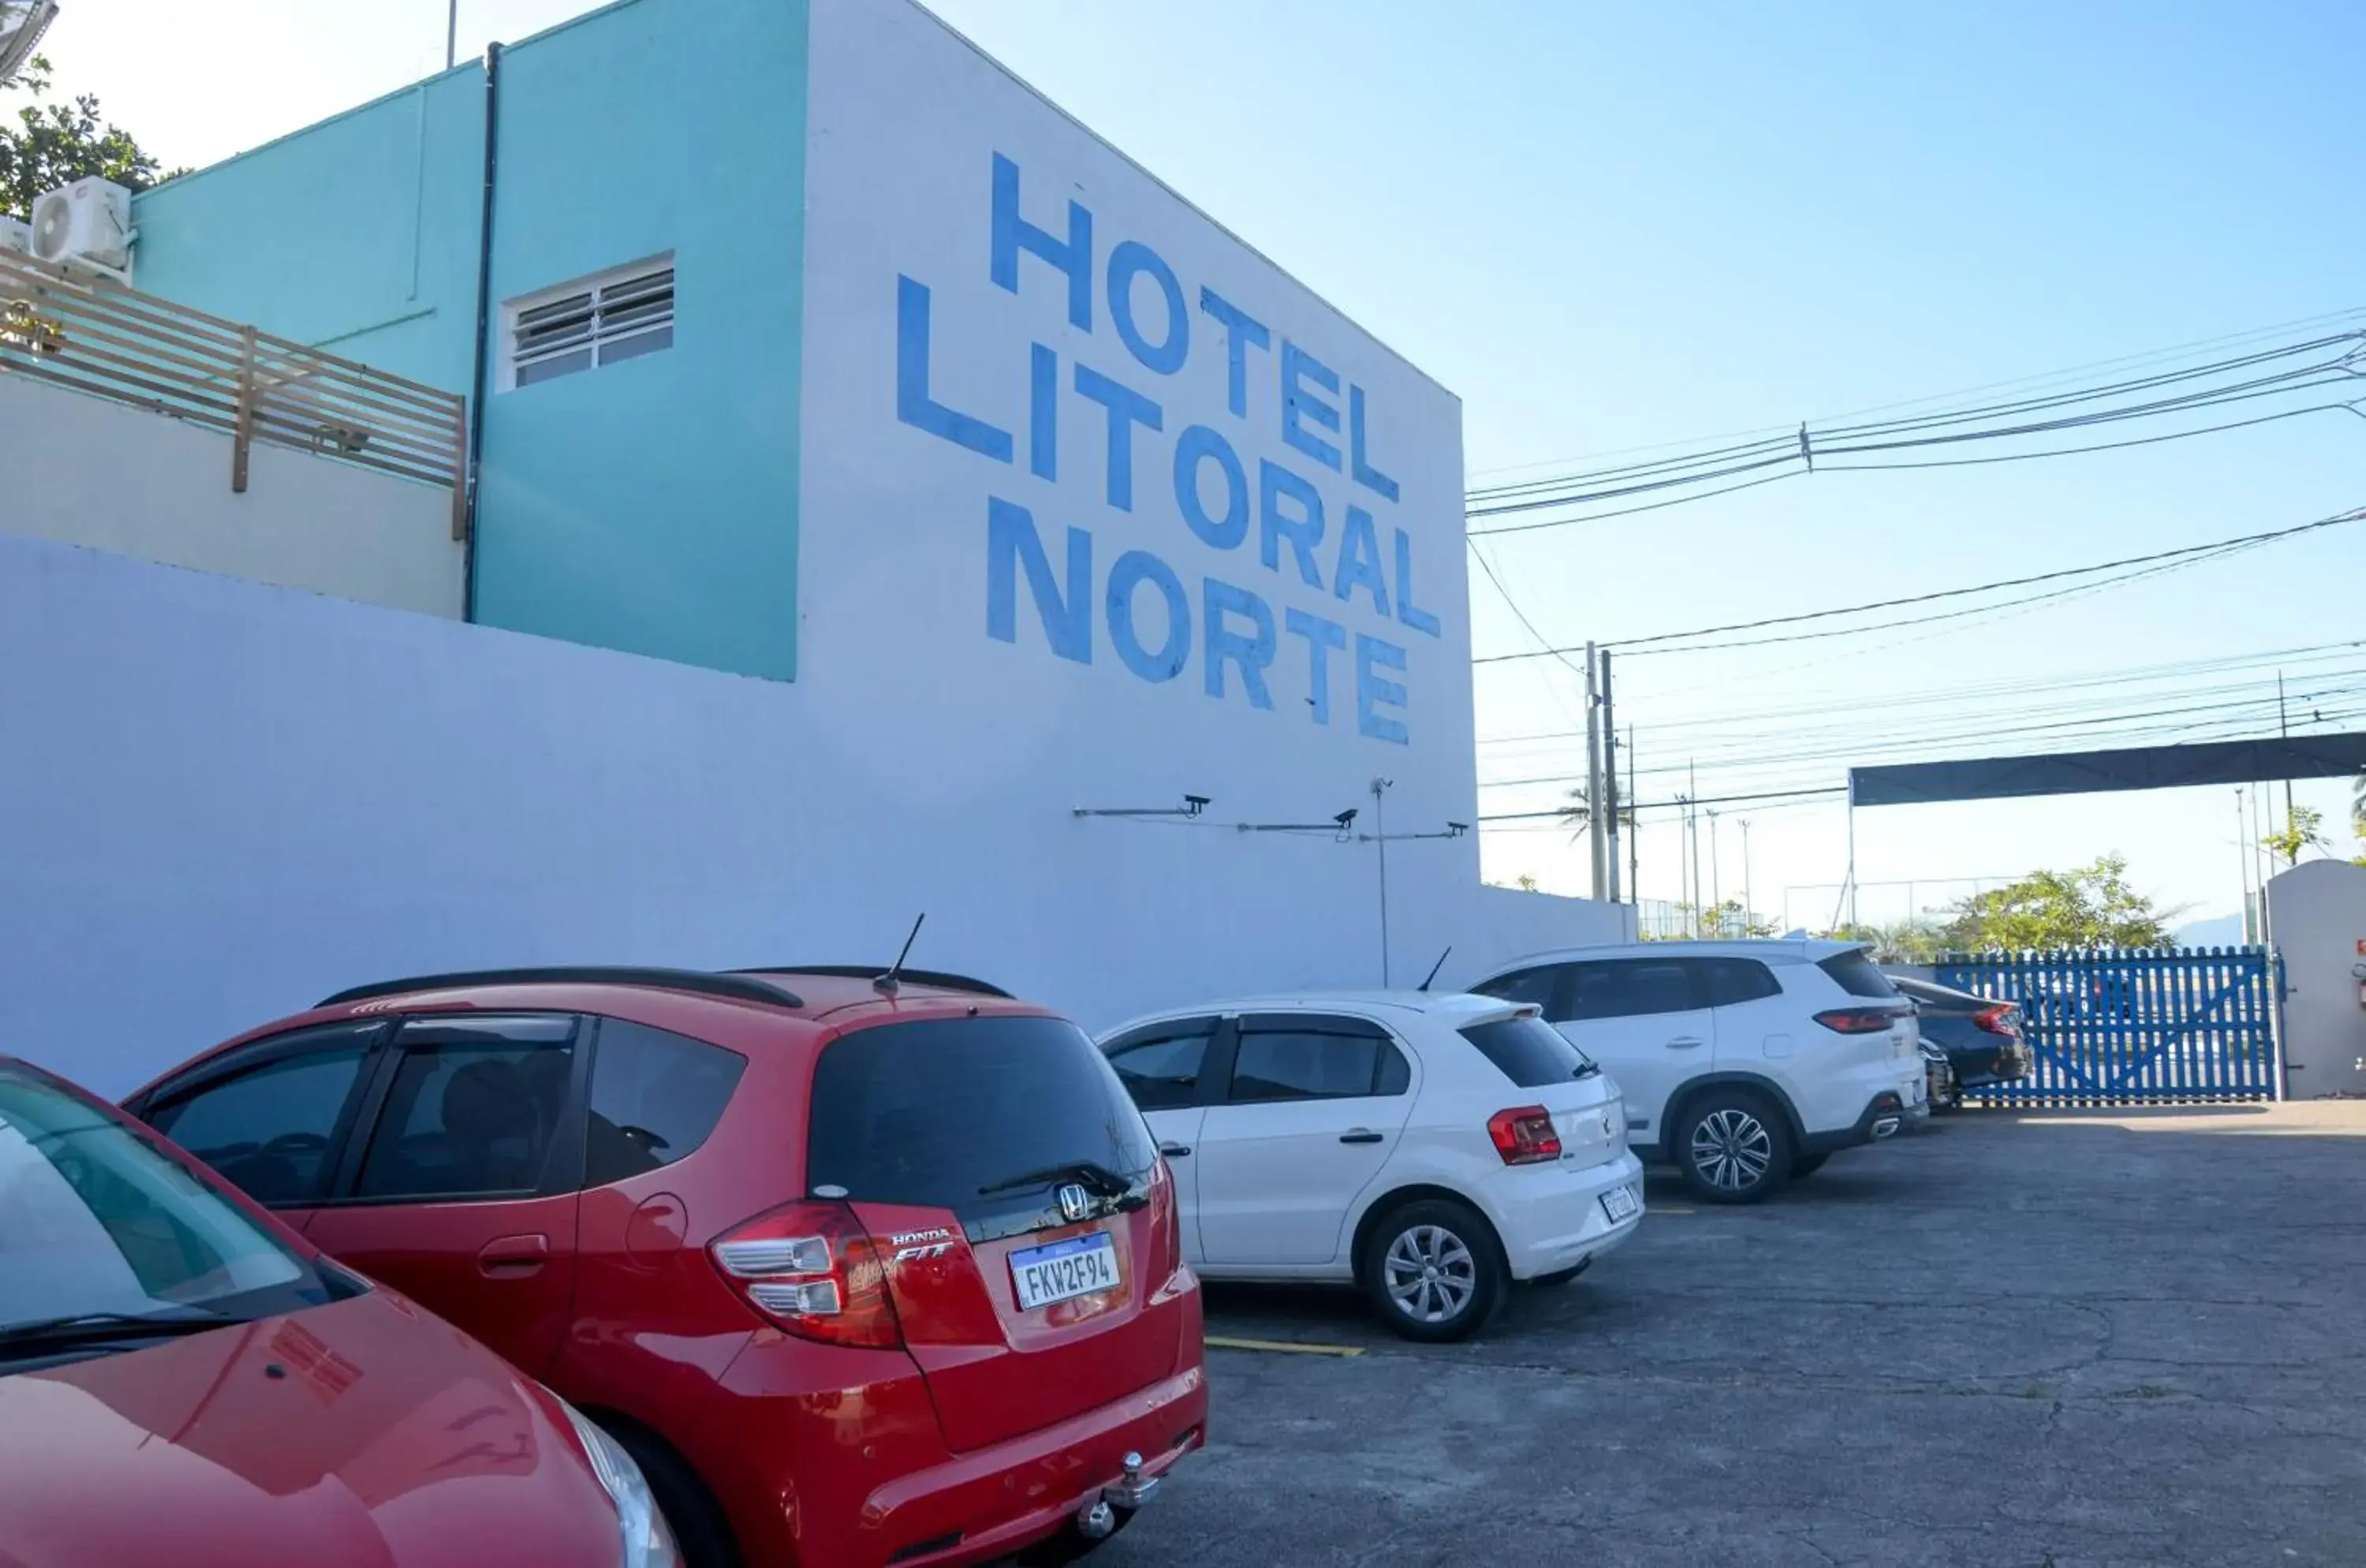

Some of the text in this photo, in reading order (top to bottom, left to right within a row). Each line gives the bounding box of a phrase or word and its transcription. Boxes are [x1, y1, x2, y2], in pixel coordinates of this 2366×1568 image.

[991, 149, 1399, 505] HOTEL
[897, 272, 1442, 639] LITORAL
[986, 494, 1409, 745] NORTE
[892, 1228, 950, 1246] HONDA
[894, 1241, 954, 1262] FIT
[1026, 1252, 1110, 1301] FKW2F94
